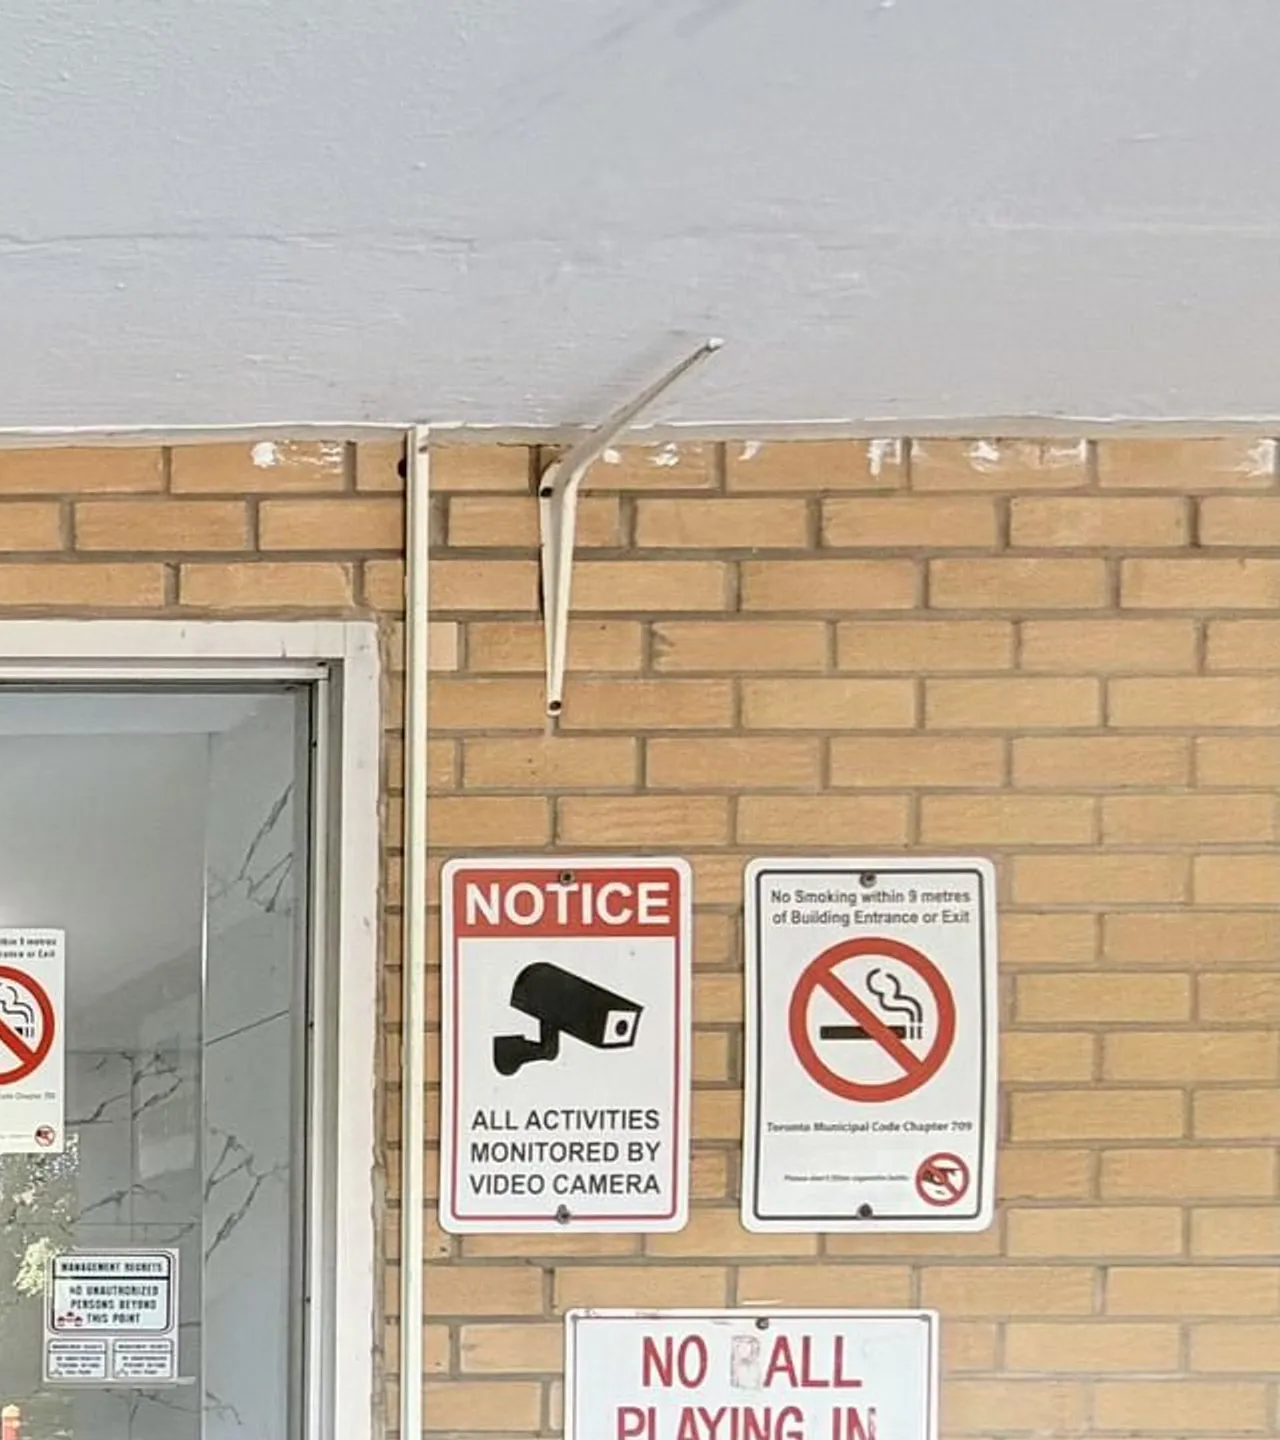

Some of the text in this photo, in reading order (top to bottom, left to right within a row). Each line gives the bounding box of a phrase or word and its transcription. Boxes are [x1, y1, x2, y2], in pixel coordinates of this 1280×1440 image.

[465, 881, 670, 926] NOTICE
[771, 890, 791, 903] No
[795, 889, 857, 907] Smoking
[861, 890, 905, 903] within
[921, 891, 971, 903] metres
[772, 910, 970, 927] of Building Entrance or Exit
[471, 1109, 660, 1130] ALL ACTIVITIES
[814, 1121, 869, 1134] Municipal
[872, 1121, 900, 1132] Code
[903, 1120, 948, 1134] Chapter
[470, 1141, 661, 1163] MONITORED BY
[469, 1173, 660, 1195] VIDEO CAMERA
[61, 1262, 120, 1272] MANAGEMENT
[86, 1285, 158, 1296] UNAUTHORIZED
[71, 1299, 157, 1309] PERSONS BEYOND
[87, 1312, 140, 1323] THIS POINT
[642, 1334, 862, 1389] NO ALL
